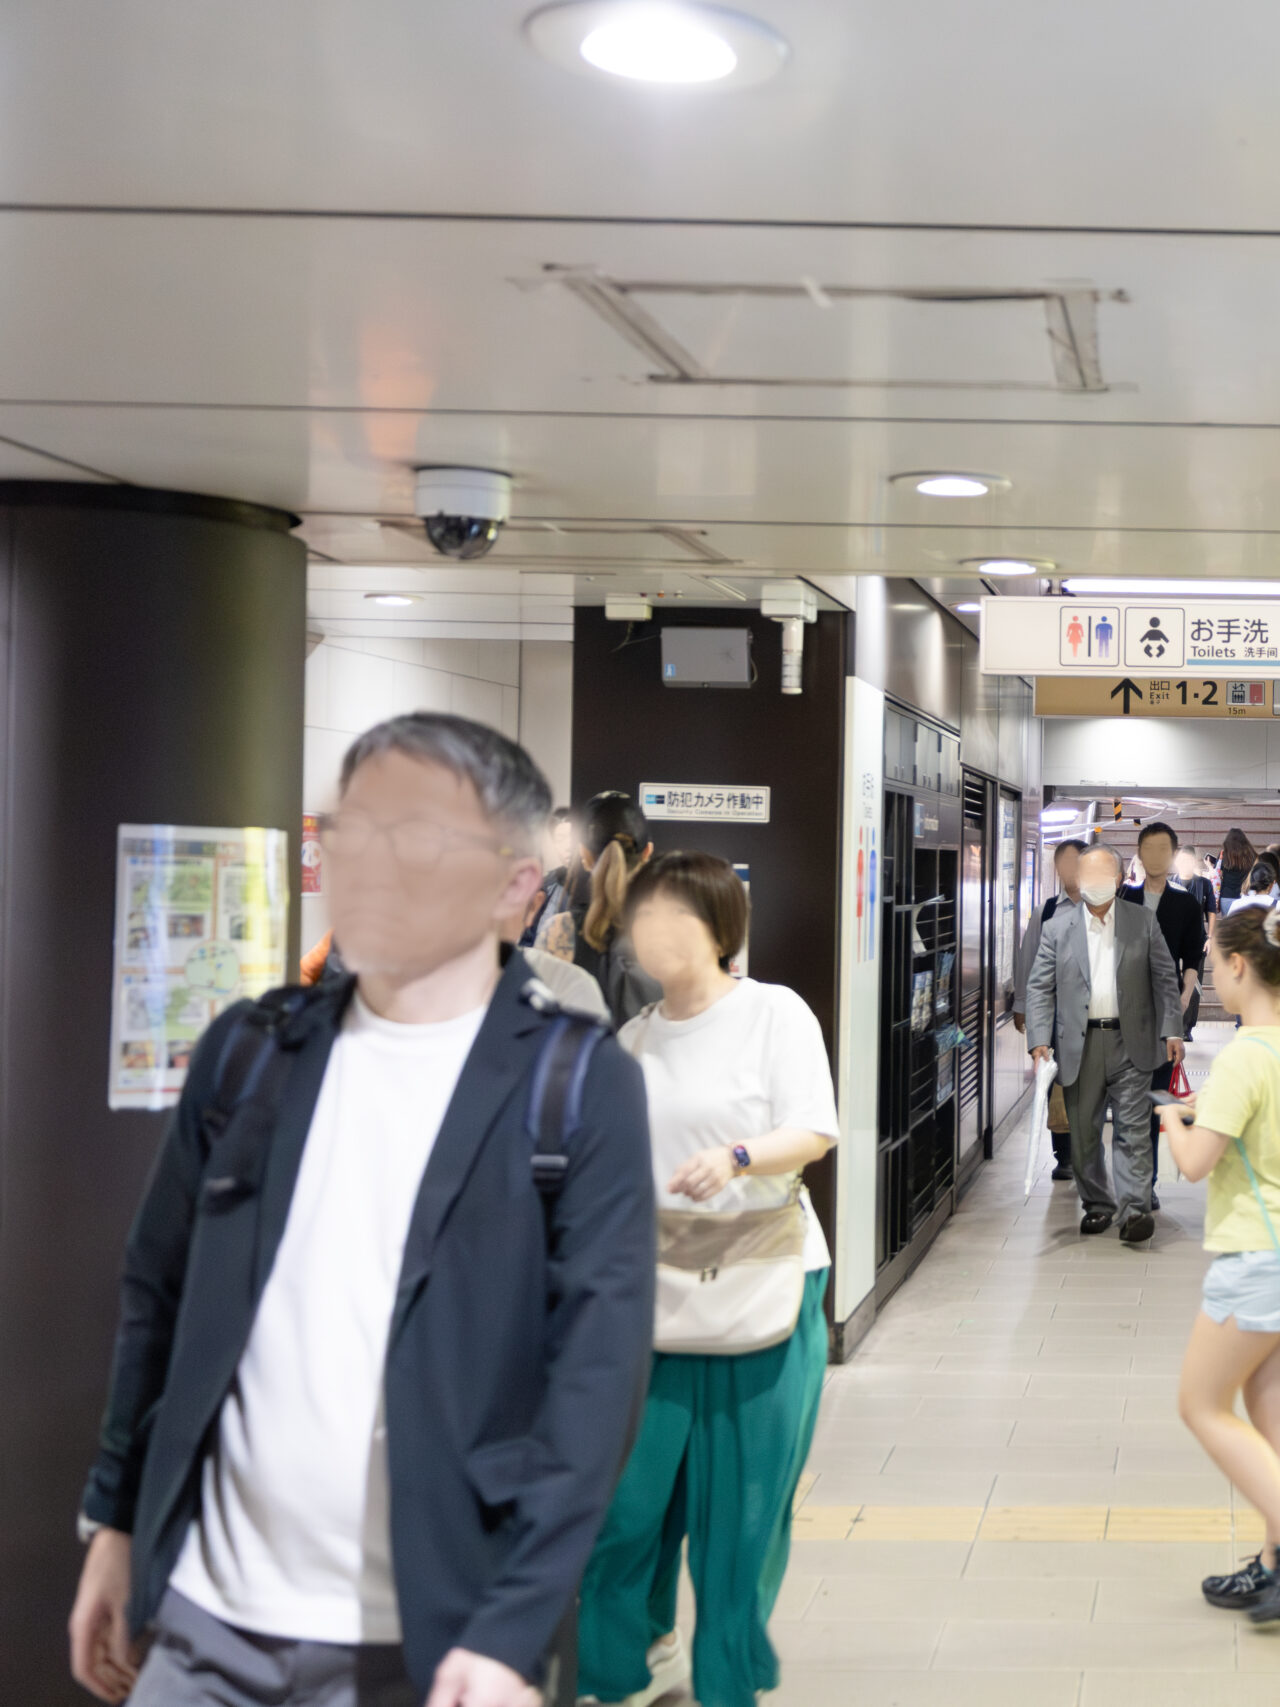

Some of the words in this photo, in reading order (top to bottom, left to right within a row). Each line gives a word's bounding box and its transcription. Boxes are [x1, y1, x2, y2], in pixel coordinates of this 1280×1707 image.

[1190, 618, 1269, 644] お手洗
[1190, 645, 1236, 658] Toilets
[1244, 646, 1278, 658] 洗手间
[1150, 680, 1170, 691] 出口
[1150, 691, 1170, 700] Exit
[1228, 707, 1246, 715] 15m
